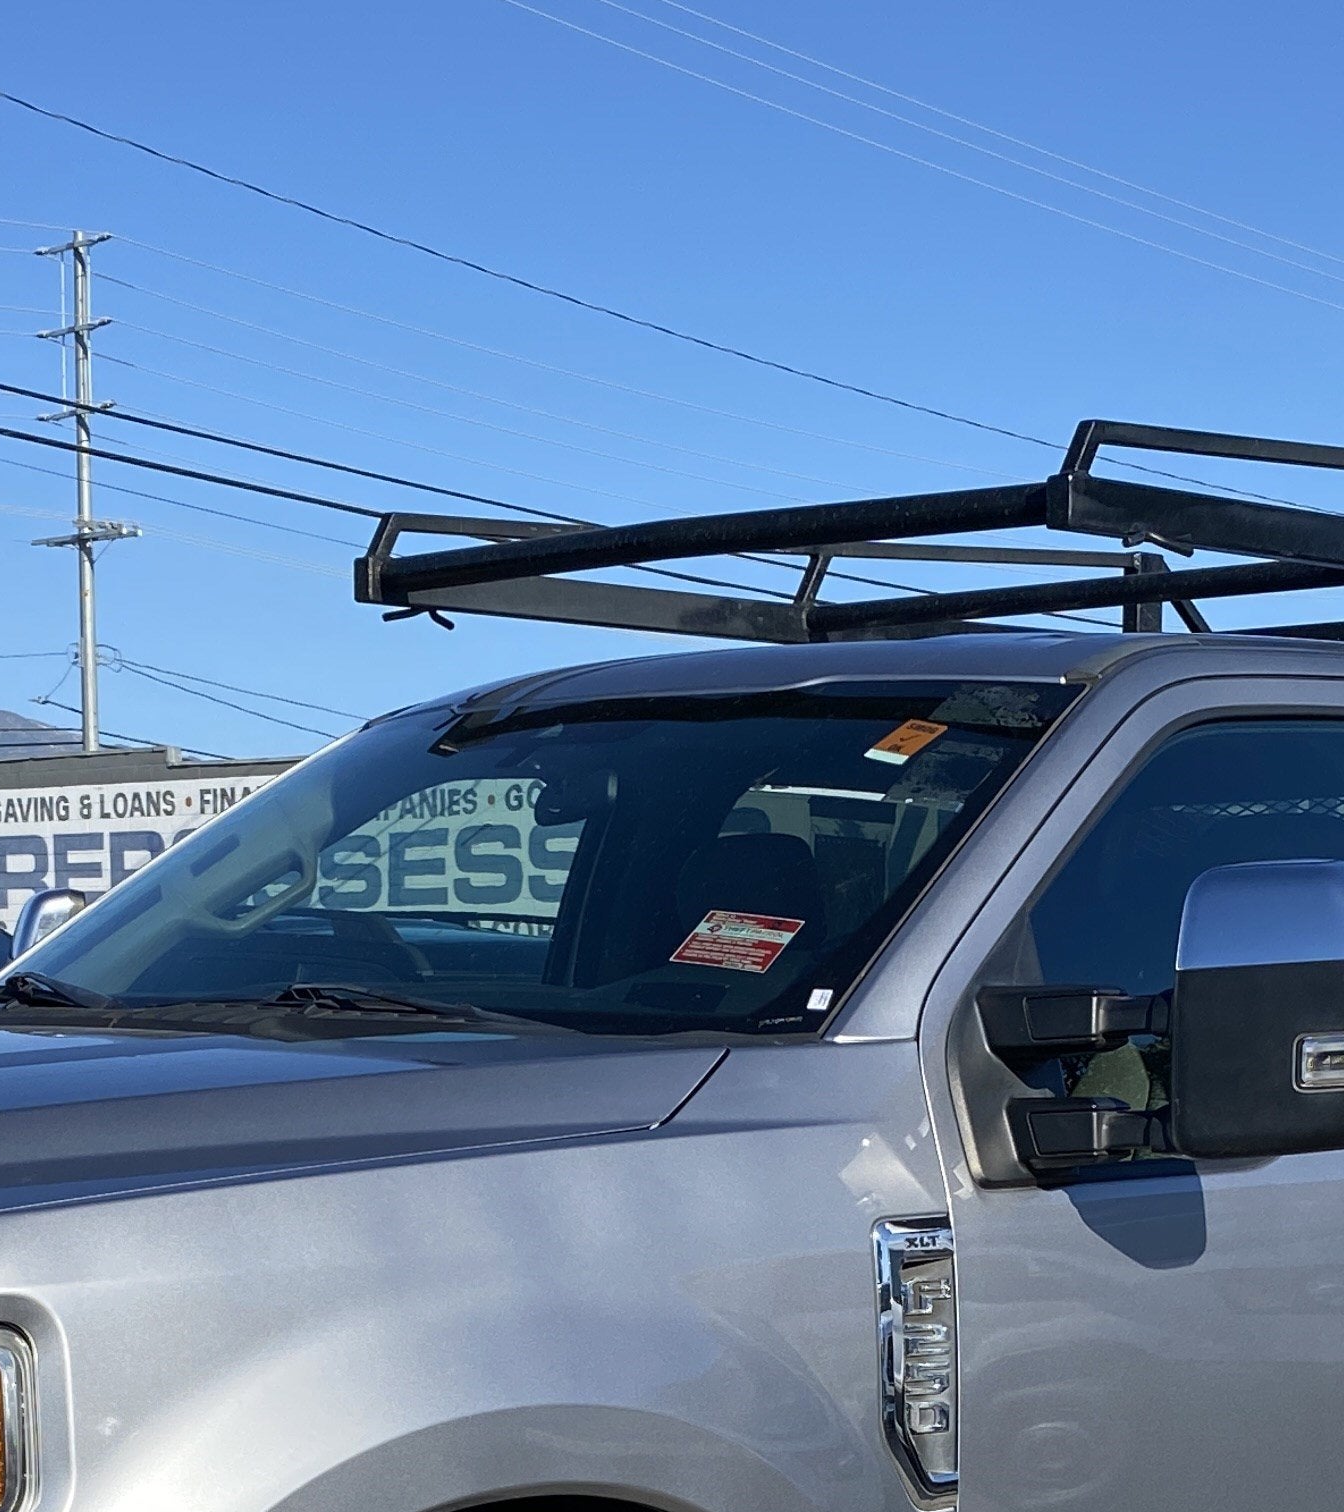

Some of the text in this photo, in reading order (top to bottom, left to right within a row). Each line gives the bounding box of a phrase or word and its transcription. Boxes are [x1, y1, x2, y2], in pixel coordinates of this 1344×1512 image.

[79, 794, 92, 819] &
[99, 790, 176, 819] LOANS
[905, 1234, 940, 1249] XLT
